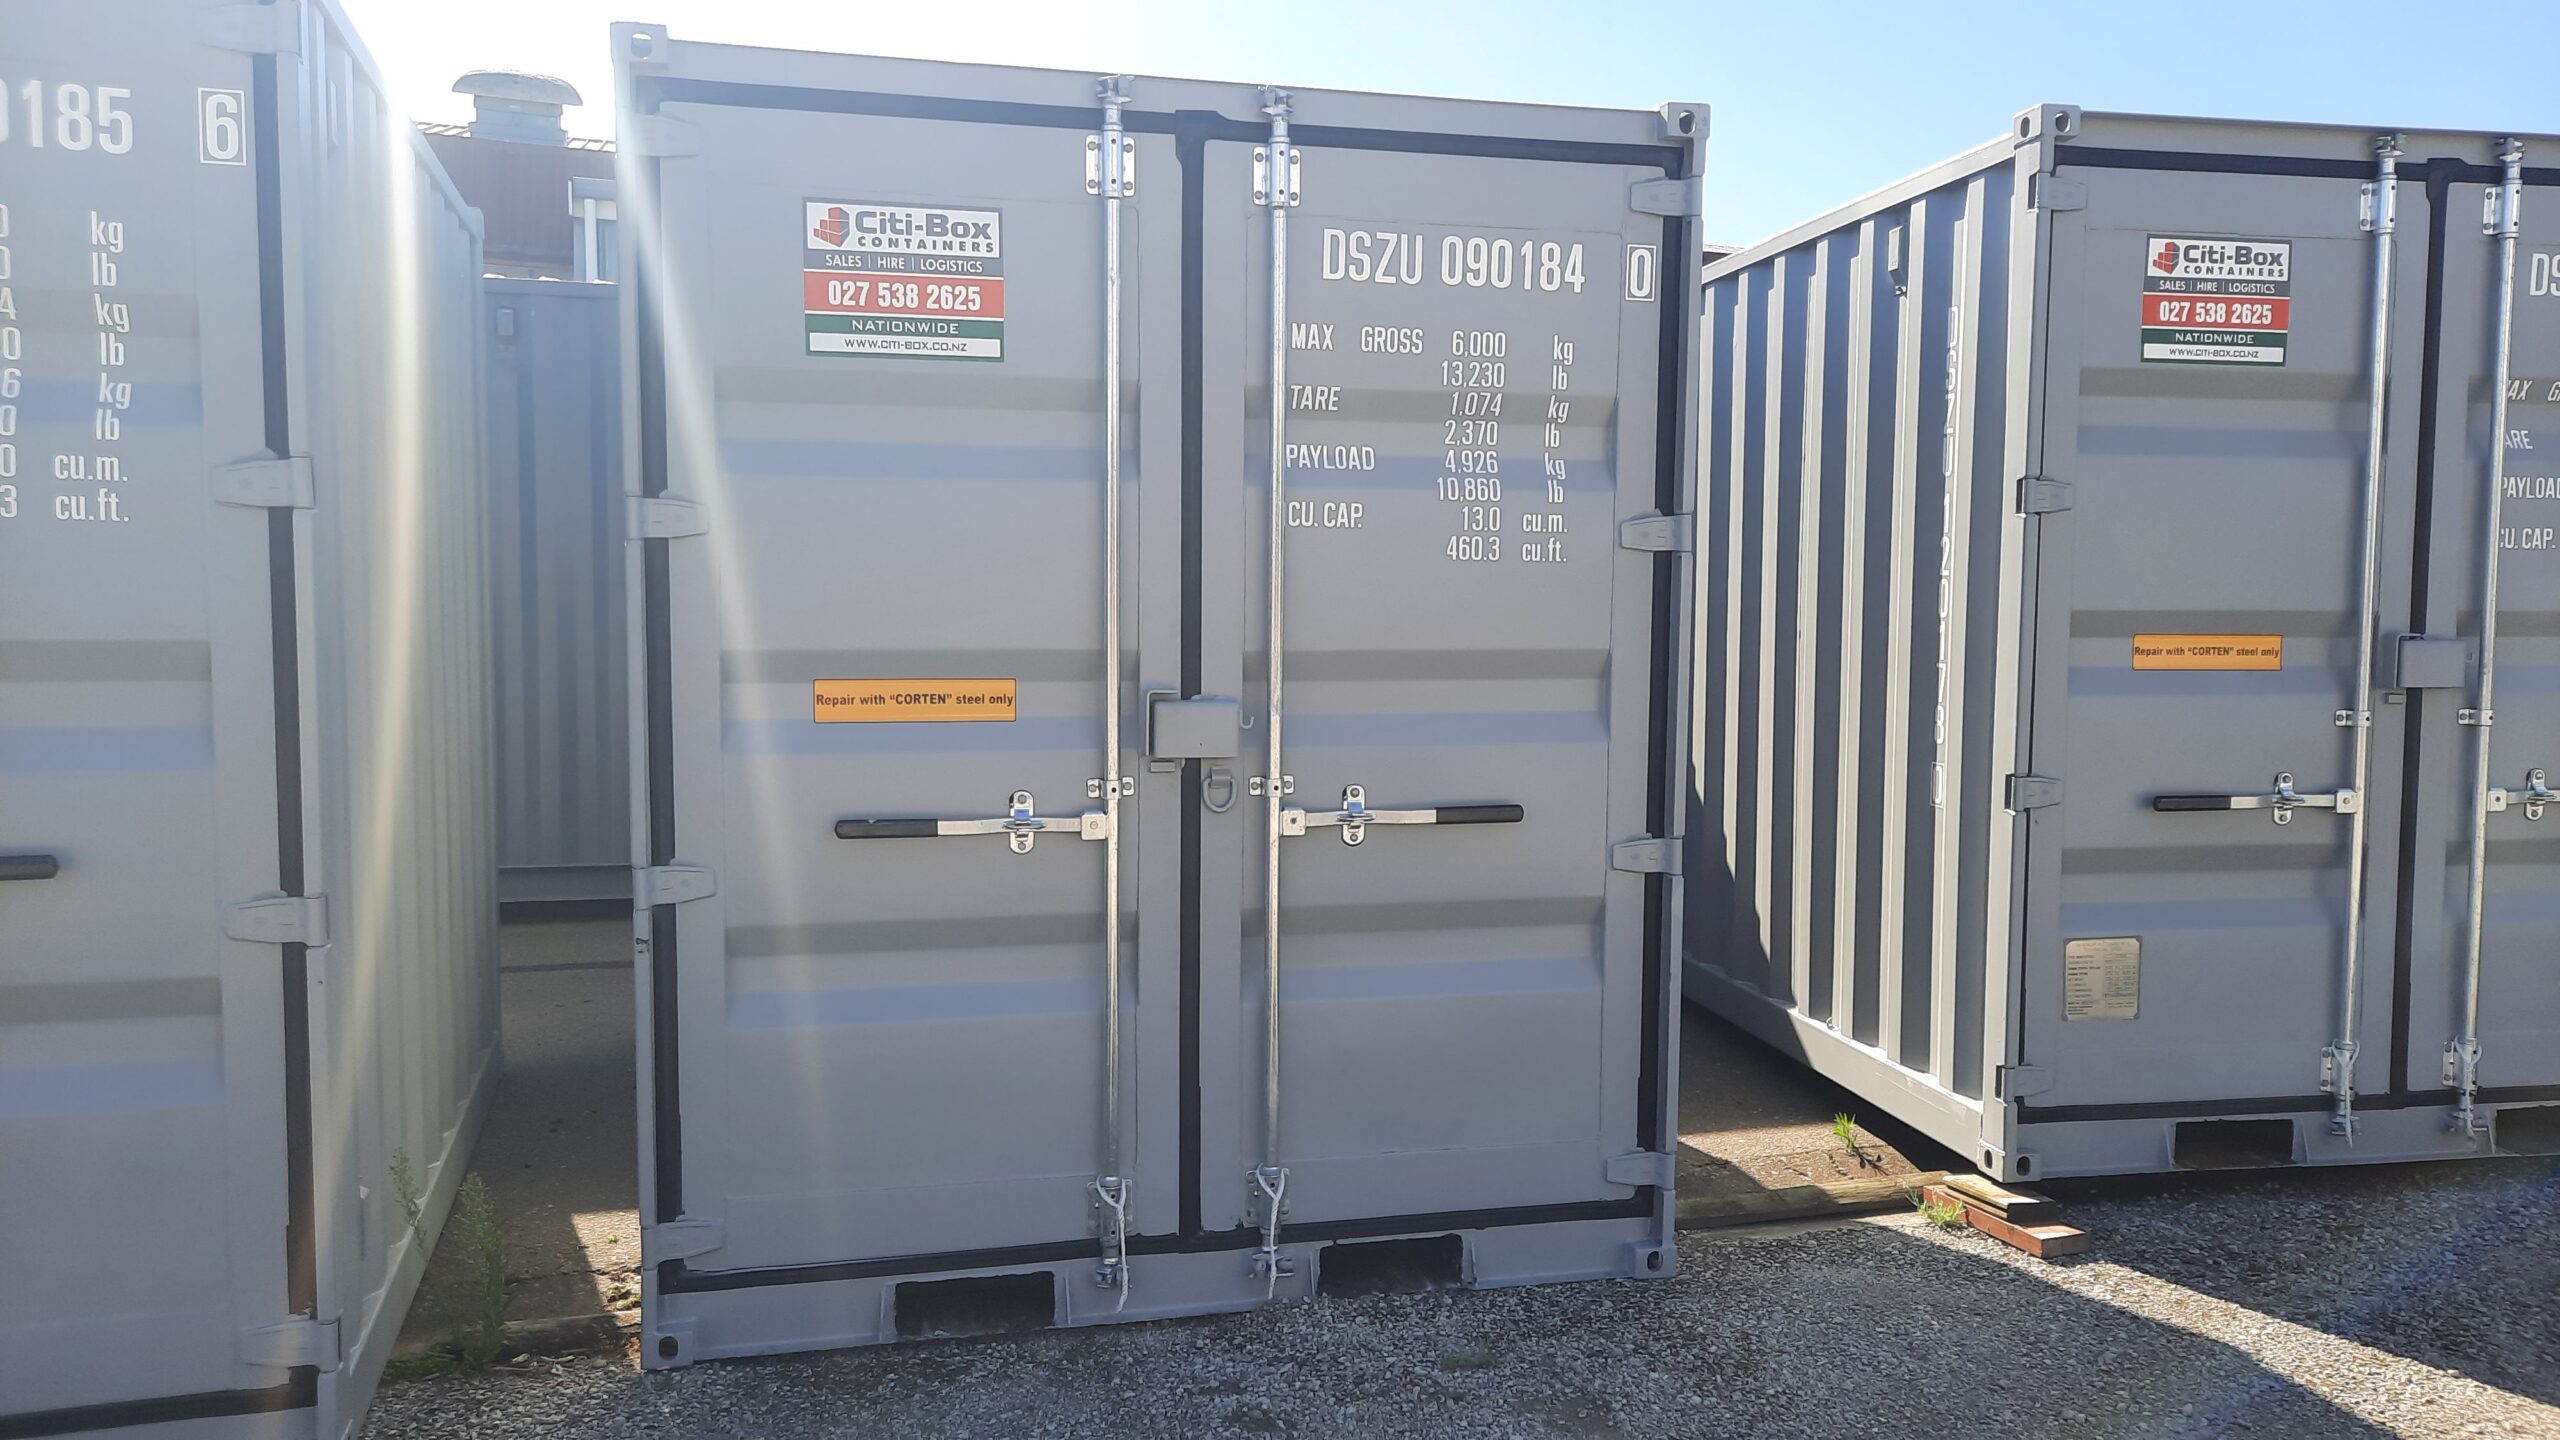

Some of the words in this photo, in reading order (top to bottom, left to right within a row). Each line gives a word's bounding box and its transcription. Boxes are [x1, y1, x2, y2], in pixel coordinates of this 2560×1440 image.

[0, 78, 134, 154] 185
[206, 93, 239, 160] 6
[90, 210, 124, 253] kg
[855, 211, 992, 240] Citi-Box
[857, 235, 994, 254] CONTAINERS
[2183, 244, 2283, 267] Citi-Box
[92, 252, 117, 287] lb
[825, 254, 863, 268] SALES
[877, 256, 905, 270] HIRE
[920, 258, 983, 273] LOGISTICS
[1322, 228, 1424, 286] DSZU
[1441, 235, 1586, 294] 090184
[1630, 248, 1653, 298] 0
[2184, 264, 2285, 278] CONTAINERS
[828, 280, 870, 307] 027
[877, 282, 919, 309] 538
[926, 284, 981, 311] 2625
[2160, 280, 2186, 291] SALES
[2196, 281, 2218, 292] HIRE
[2229, 282, 2275, 294] LOGISTICS
[94, 293, 130, 333] kg
[2159, 300, 2191, 322] 027
[2195, 302, 2227, 323] 538
[2231, 303, 2273, 325] 2625
[852, 319, 959, 335] NATIONWIDE
[2175, 332, 2255, 344] NATIONWIDE
[100, 332, 125, 366] lb
[844, 338, 968, 353] WWW.CITI-BOX.CO.NZ
[1291, 322, 1334, 351] MAX
[1361, 326, 1424, 355] GROSS
[1452, 330, 1506, 358] 6,000
[1553, 334, 1574, 366] kg
[1441, 360, 1505, 389] 13,230
[1552, 365, 1568, 390] lb
[98, 373, 132, 410] kg
[1290, 384, 1341, 411] TARE
[1451, 391, 1503, 417] 1,074
[1547, 394, 1570, 424] kg
[2508, 379, 2533, 401] AX
[95, 408, 120, 441] lb
[1444, 419, 1499, 446] 2,370
[1544, 422, 1560, 448] lb
[54, 454, 128, 482] cu.m.
[1286, 444, 1376, 471] PAYLOAD
[1445, 449, 1499, 474] 4,926
[1544, 452, 1566, 480] kg
[1436, 476, 1502, 502] 10,860
[1547, 479, 1564, 503] lb
[55, 487, 129, 522] cu.ft.
[1462, 505, 1501, 532] 13.0
[1522, 513, 1568, 533] cu.m.
[1446, 535, 1501, 561] 460.3
[1522, 537, 1567, 562] cu.ft.
[2522, 527, 2556, 550] CAP.
[2134, 646, 2163, 658] Repair
[2166, 646, 2185, 656] with
[2236, 647, 2258, 657] steel
[2261, 647, 2280, 659] only
[816, 694, 855, 708] Repair
[860, 693, 886, 705] with
[956, 693, 985, 705] steel
[989, 693, 1013, 707] only
